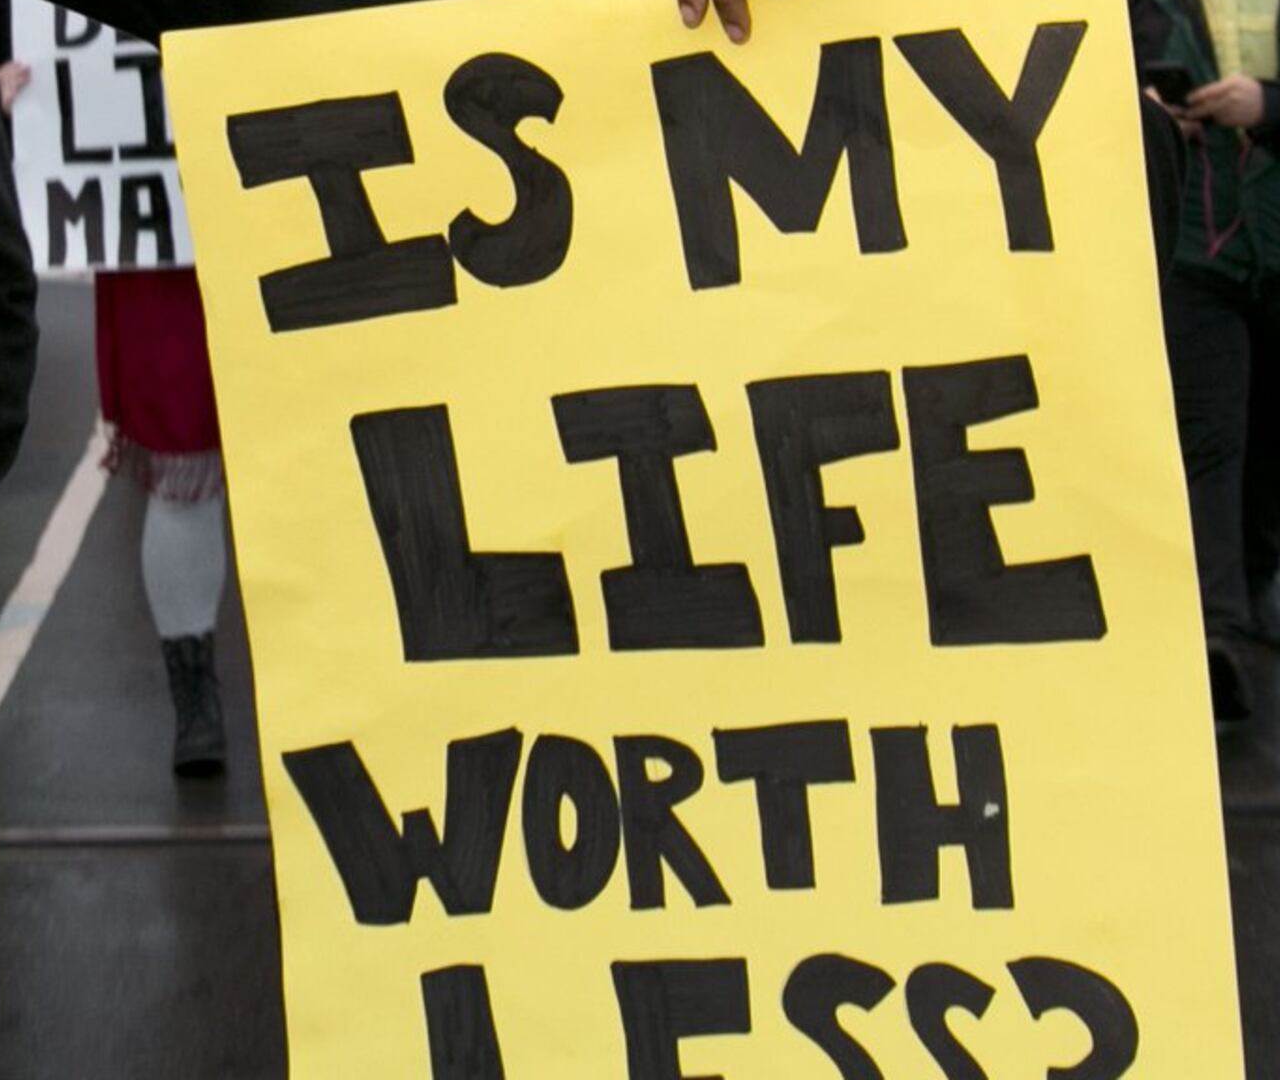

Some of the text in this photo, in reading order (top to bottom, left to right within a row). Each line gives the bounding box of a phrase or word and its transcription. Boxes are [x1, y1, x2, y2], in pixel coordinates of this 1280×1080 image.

[55, 52, 177, 165] LI
[226, 21, 1089, 333] IS MY
[46, 174, 176, 267] MA
[350, 354, 1108, 662] LIFE
[282, 719, 1014, 926] WORTH
[420, 953, 1140, 1080] LESS?
